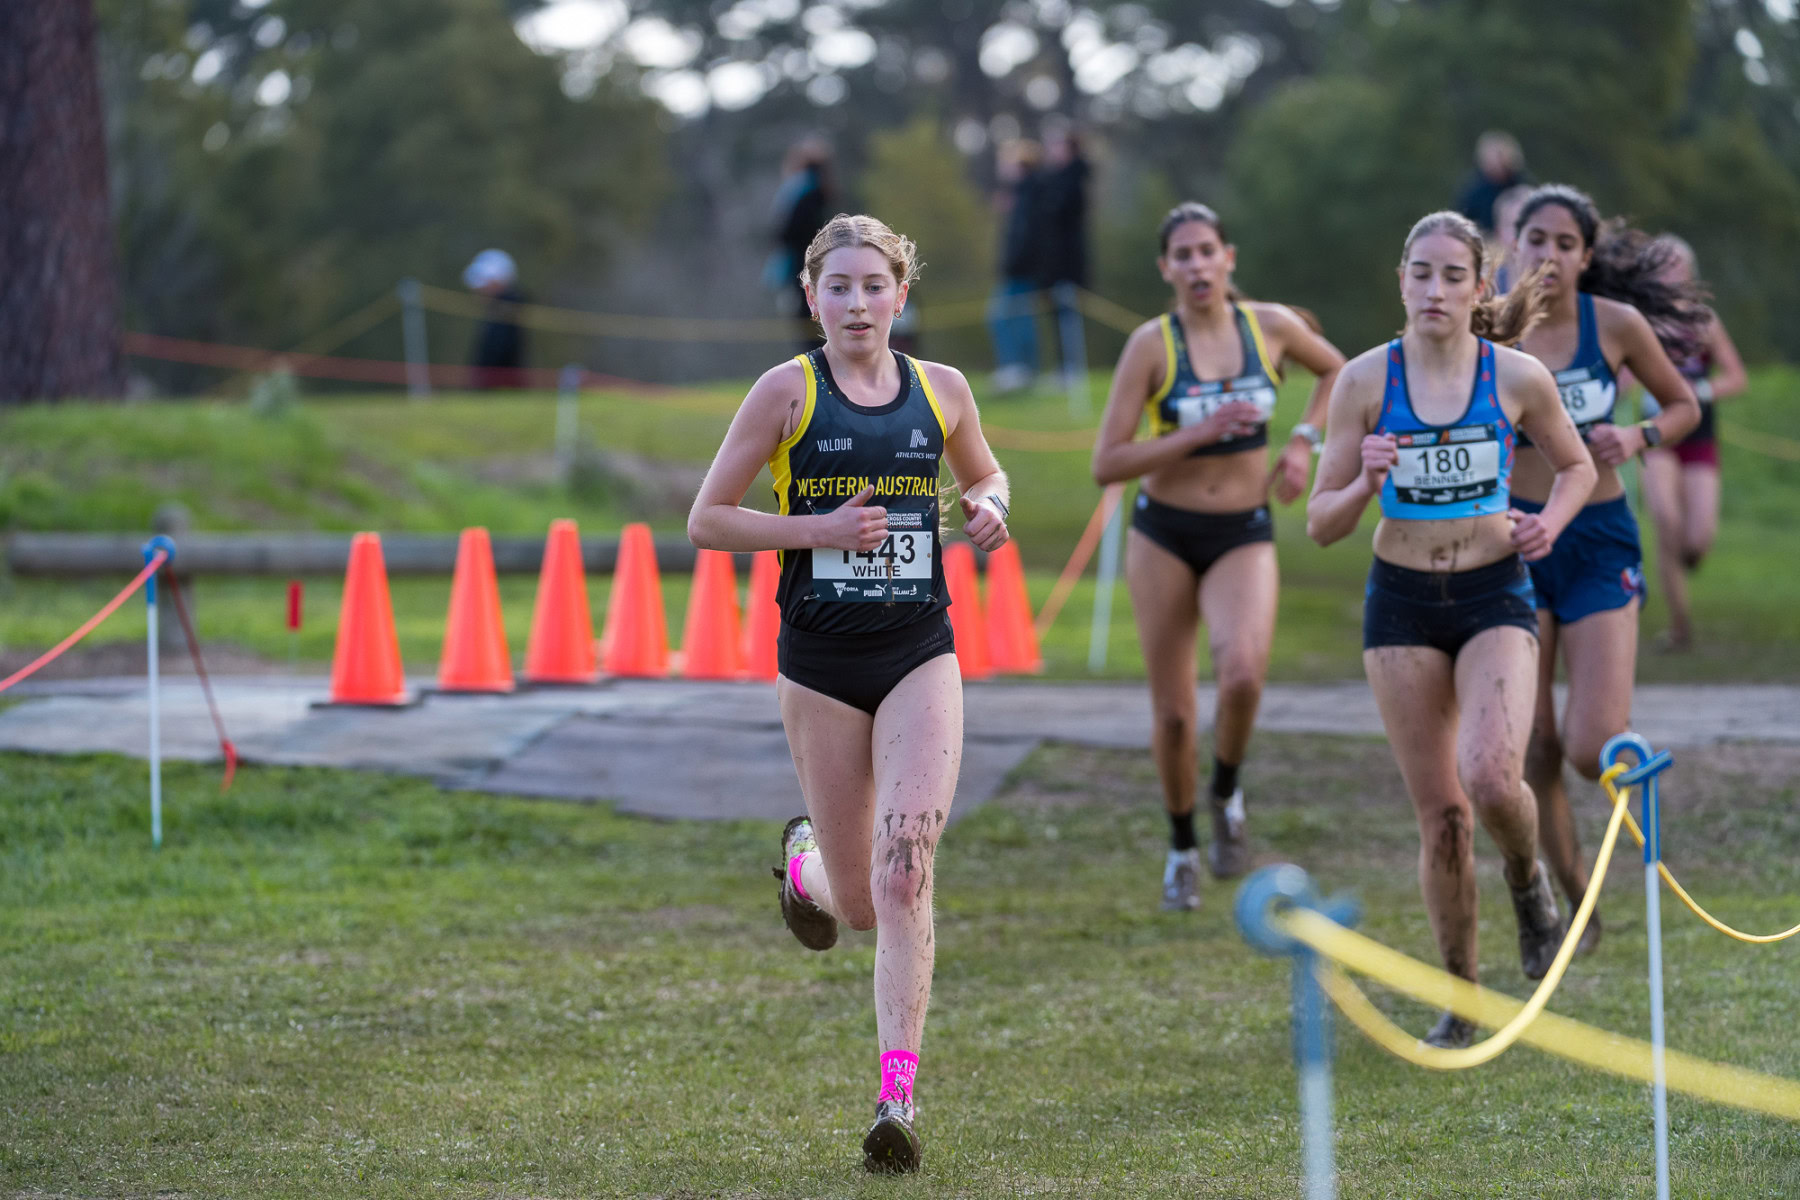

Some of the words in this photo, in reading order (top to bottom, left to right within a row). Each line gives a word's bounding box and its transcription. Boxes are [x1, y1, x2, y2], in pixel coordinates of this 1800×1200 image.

[817, 438, 852, 452] VALOUR
[895, 451, 925, 459] ATHLETICS
[1417, 447, 1470, 474] 180
[796, 477, 868, 496] WESTERN
[852, 565, 901, 577] WHITE
